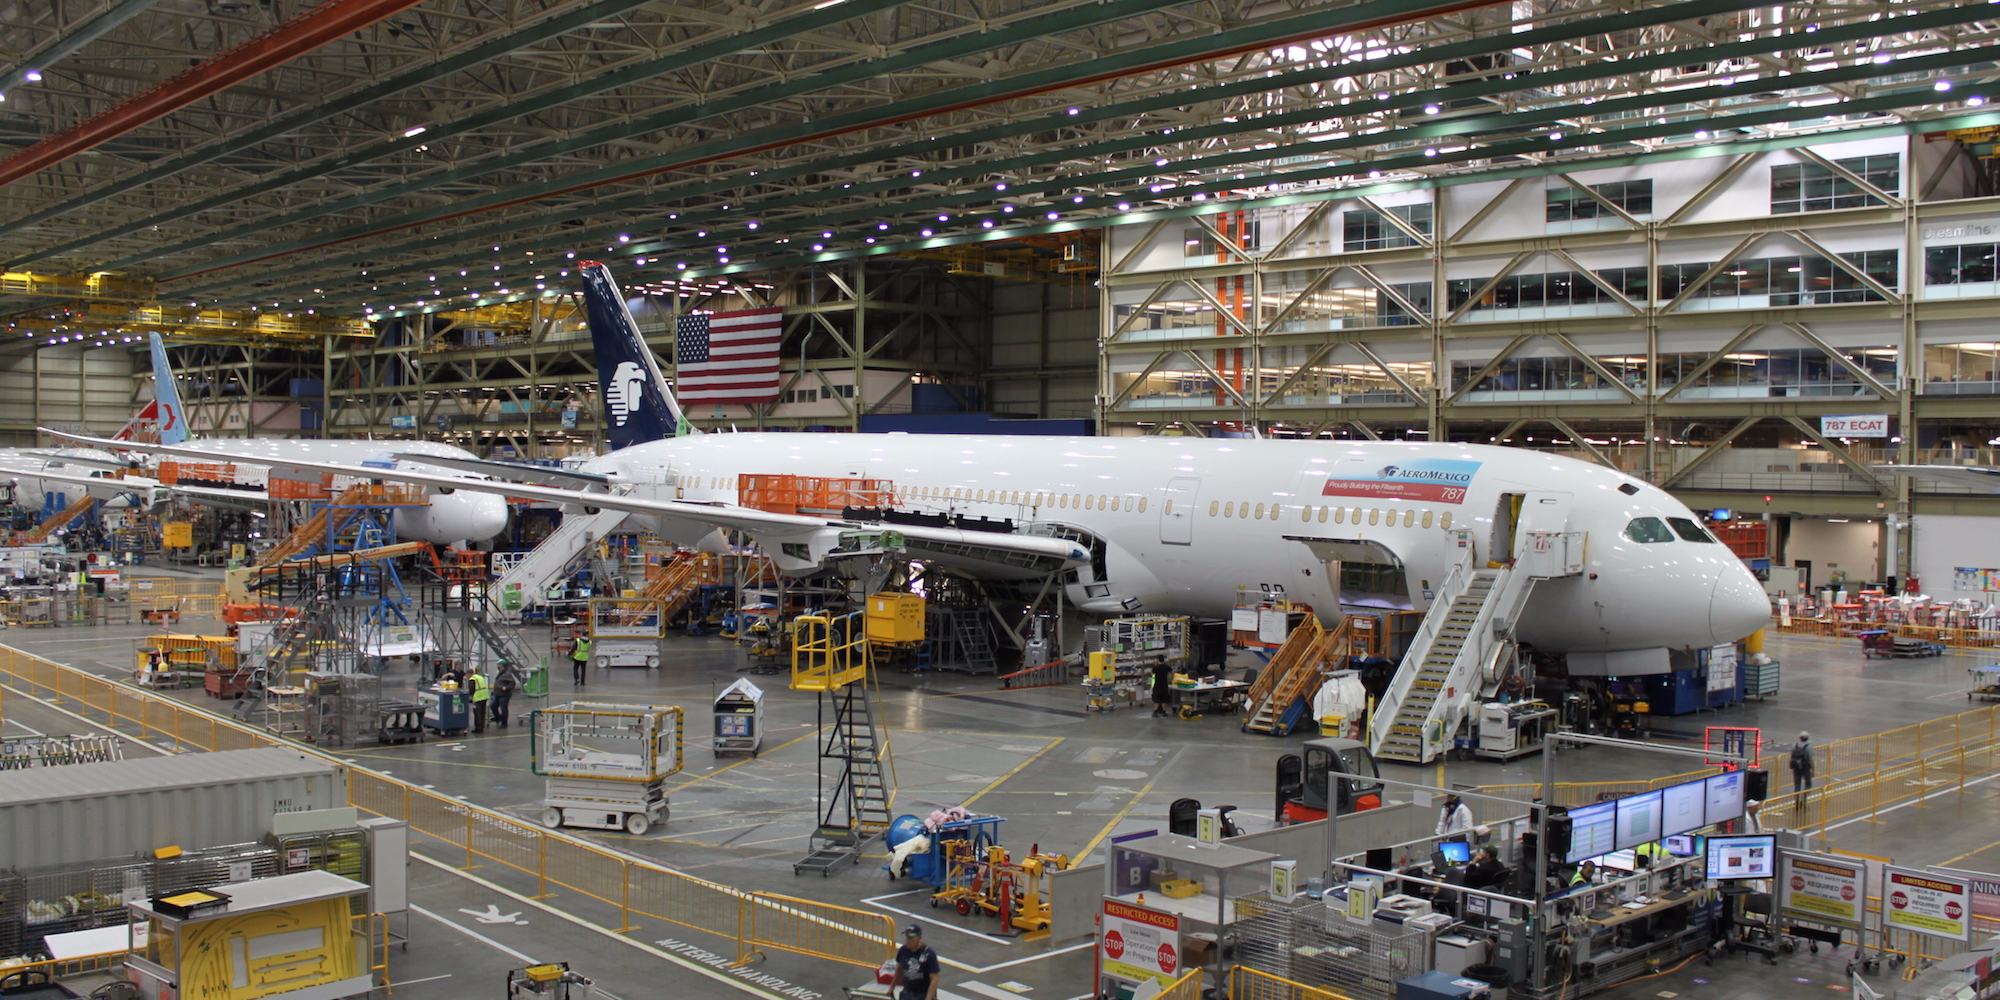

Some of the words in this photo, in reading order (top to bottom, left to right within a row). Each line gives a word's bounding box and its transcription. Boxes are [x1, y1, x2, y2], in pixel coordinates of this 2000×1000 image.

[1923, 225, 1997, 239] Dreamliner
[1825, 421, 1846, 430] 787
[1850, 421, 1883, 430] ECAT
[1398, 469, 1470, 482] AEROMEXICO
[1329, 481, 1349, 490] Proudly
[1349, 482, 1370, 491] Building
[1441, 487, 1466, 500] 787
[1796, 861, 1829, 872] RESTRICTED
[1829, 866, 1852, 876] ACCESS
[1791, 879, 1805, 887] STOP
[1807, 880, 1839, 892] REQUIRED
[1901, 877, 1926, 887] LIMITED
[1926, 881, 1953, 891] ACCESS
[1973, 881, 2000, 895] NIN
[1841, 889, 1856, 897] STOP
[1910, 887, 1936, 896] CHECK-IN
[1890, 895, 1908, 905] STOP
[1107, 904, 1148, 921] RESTRICTED
[1149, 914, 1175, 928] ACCESS
[1944, 905, 1962, 915] STOP
[1105, 938, 1124, 951] STOP
[1125, 938, 1157, 953] Operations
[1132, 951, 1156, 964] Progress
[1158, 951, 1176, 965] STOP
[655, 938, 734, 970] MATERIAL
[728, 966, 822, 1000] HANDLING
